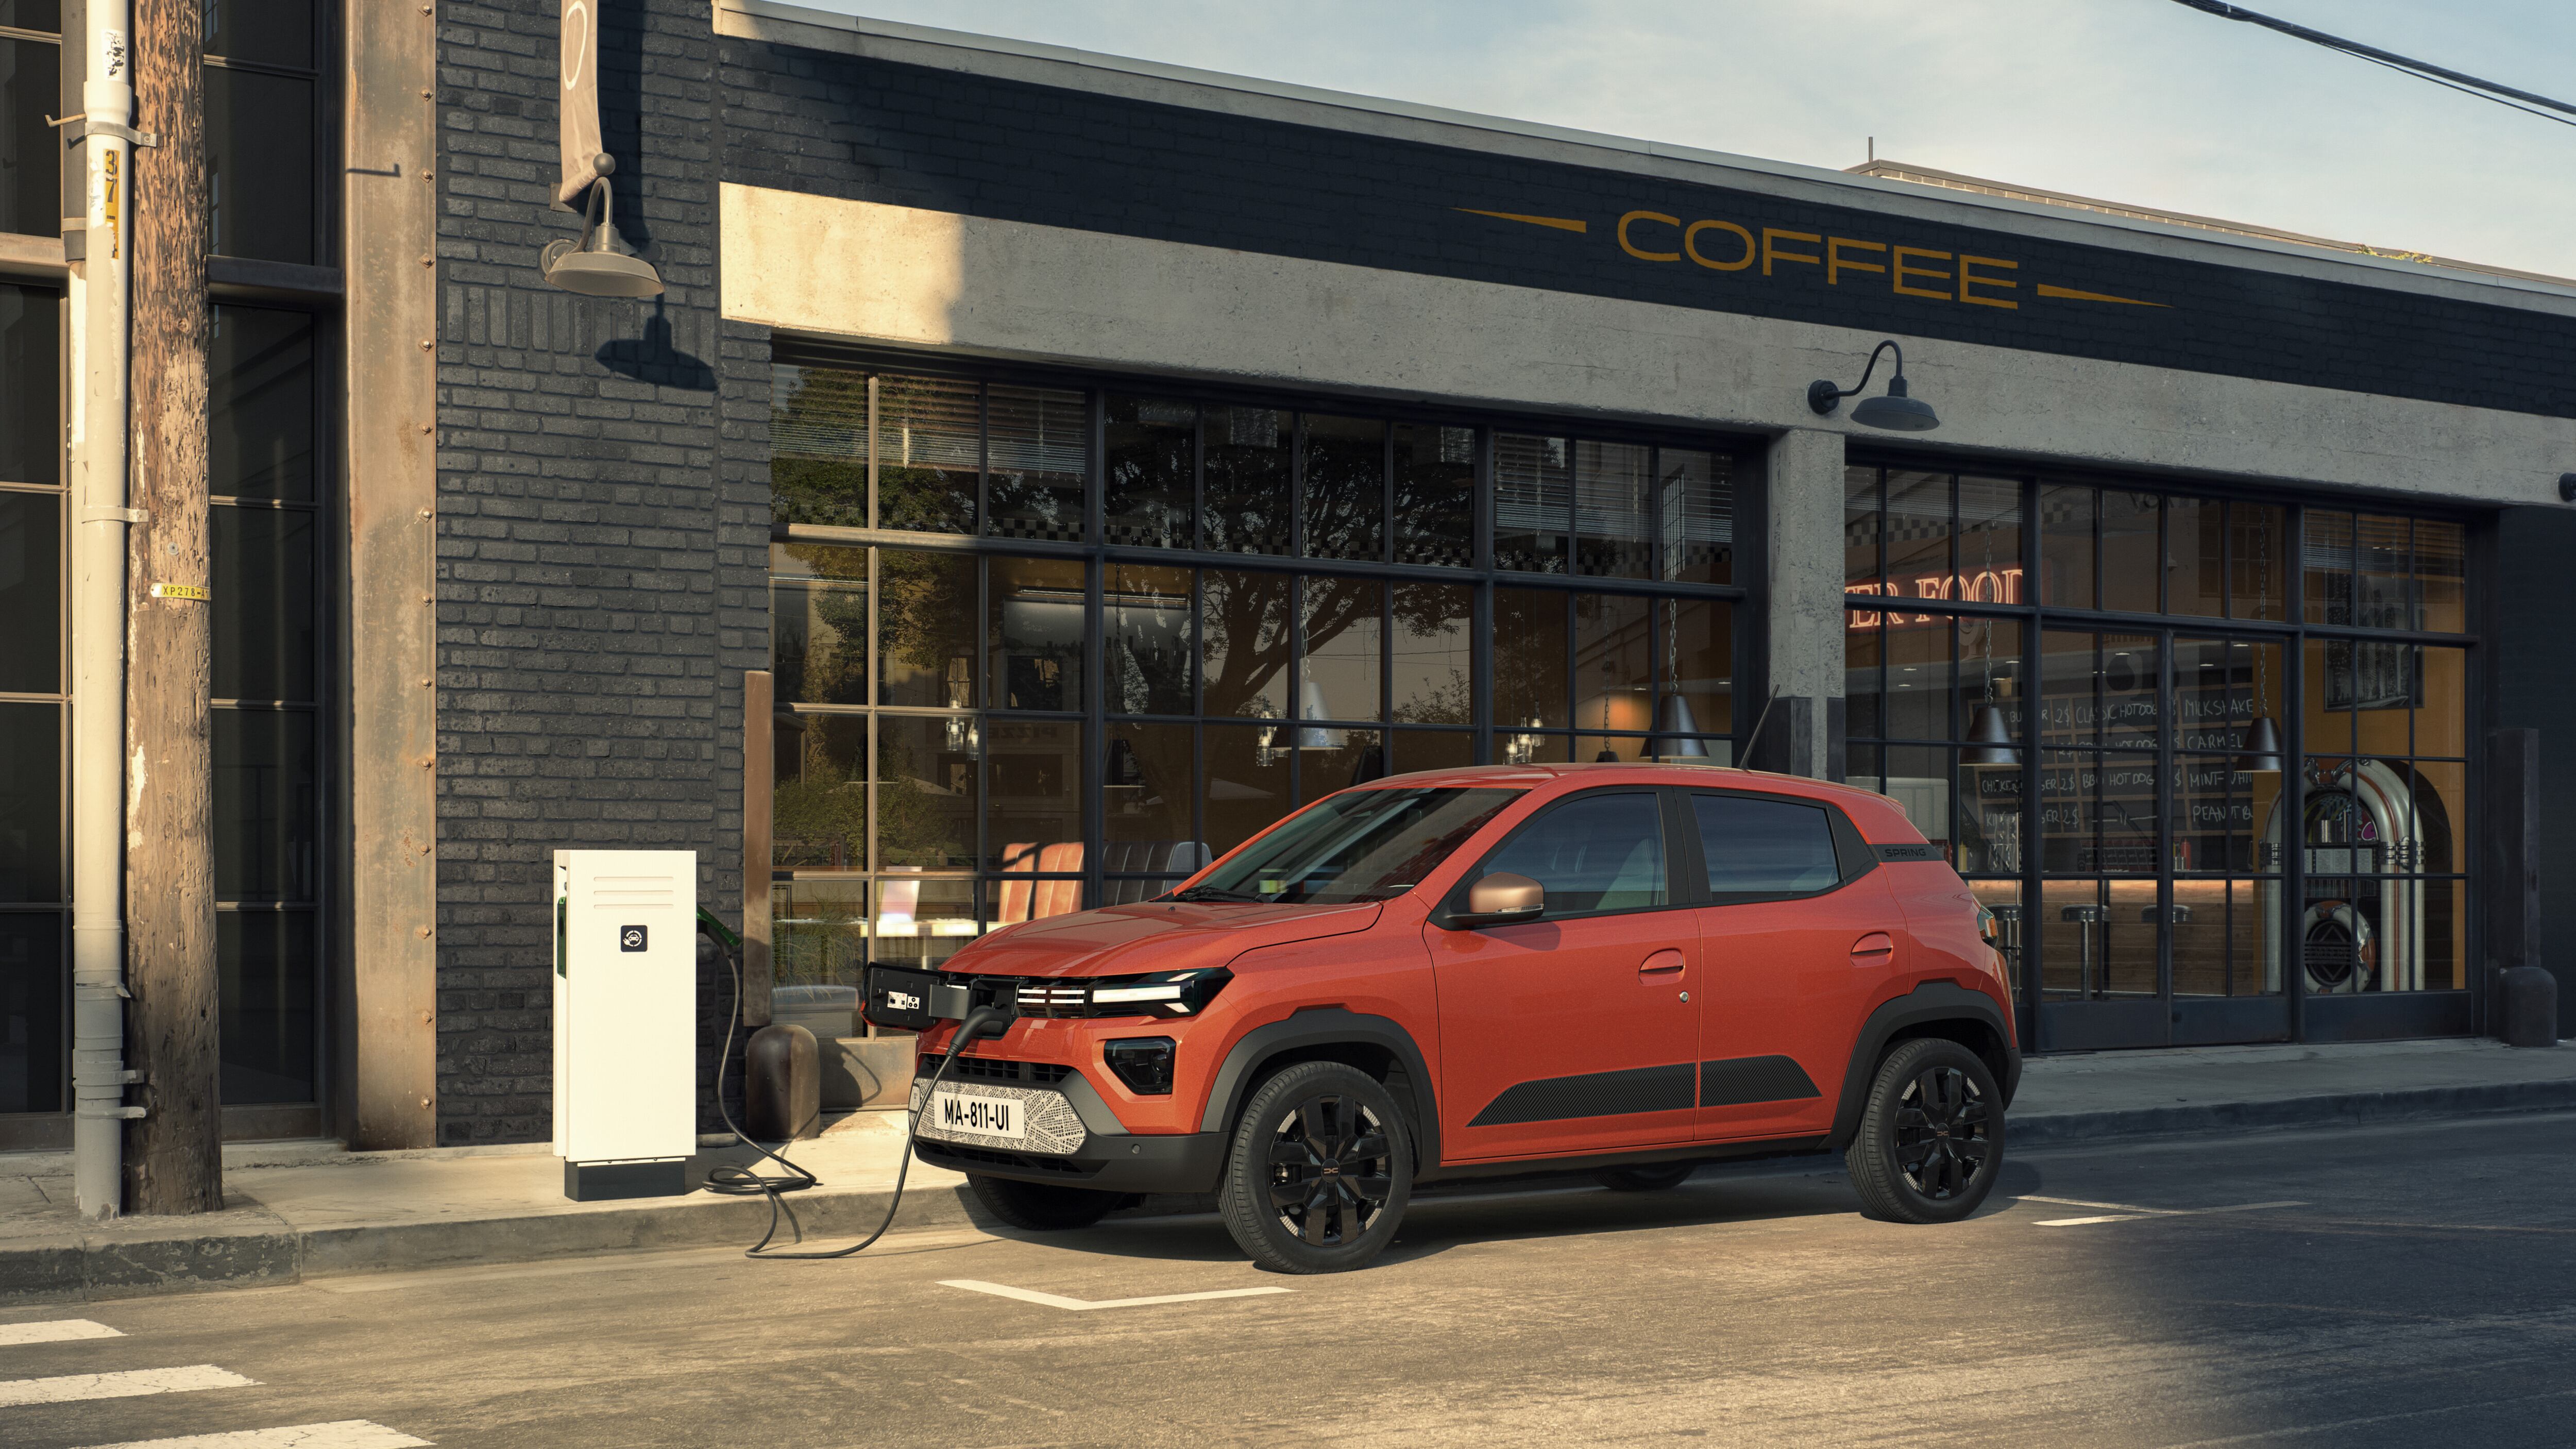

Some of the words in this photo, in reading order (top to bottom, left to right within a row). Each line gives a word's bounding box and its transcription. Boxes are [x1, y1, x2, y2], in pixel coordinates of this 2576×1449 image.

[1617, 210, 2019, 309] COFFEE
[1844, 583, 1904, 628] ER
[1885, 848, 1926, 857] SPRING
[945, 1098, 1009, 1131] MA-811-UI
